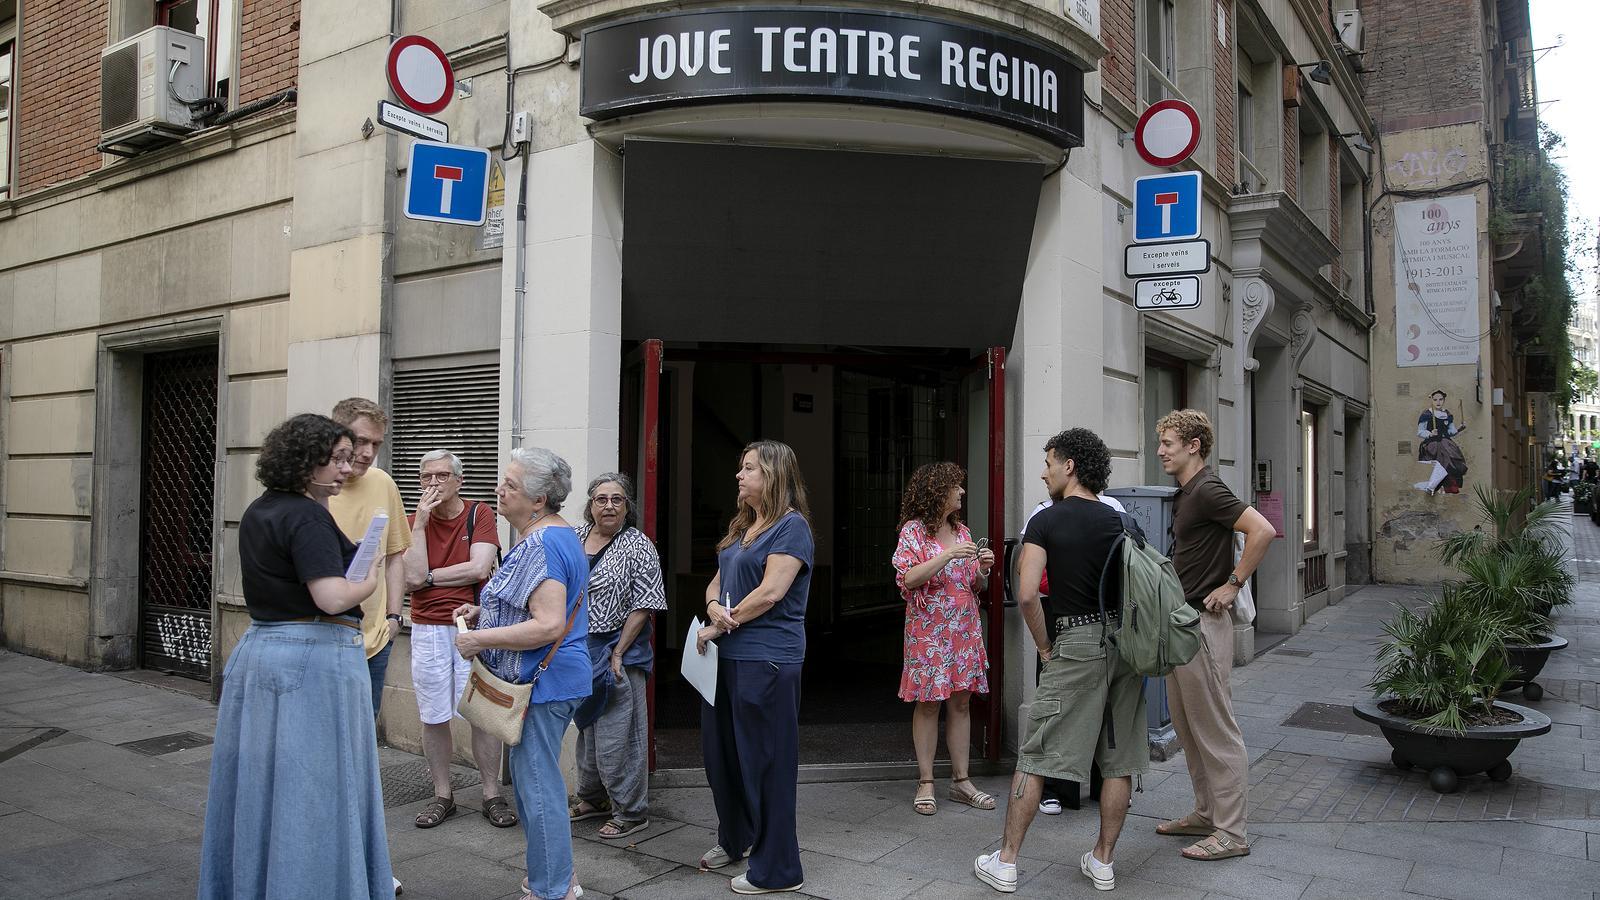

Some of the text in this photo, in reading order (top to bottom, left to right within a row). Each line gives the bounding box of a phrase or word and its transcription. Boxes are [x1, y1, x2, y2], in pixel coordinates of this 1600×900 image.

[629, 26, 1060, 113] JOVE TEATRE REGINA
[387, 110, 406, 123] Excepte
[426, 125, 443, 136] serveis
[1421, 208, 1441, 219] 100
[1426, 219, 1461, 235] anys
[1142, 251, 1169, 260] Excepte
[1156, 261, 1180, 269] serveis
[1406, 265, 1463, 279] 1913-2013
[1153, 280, 1181, 288] excepte
